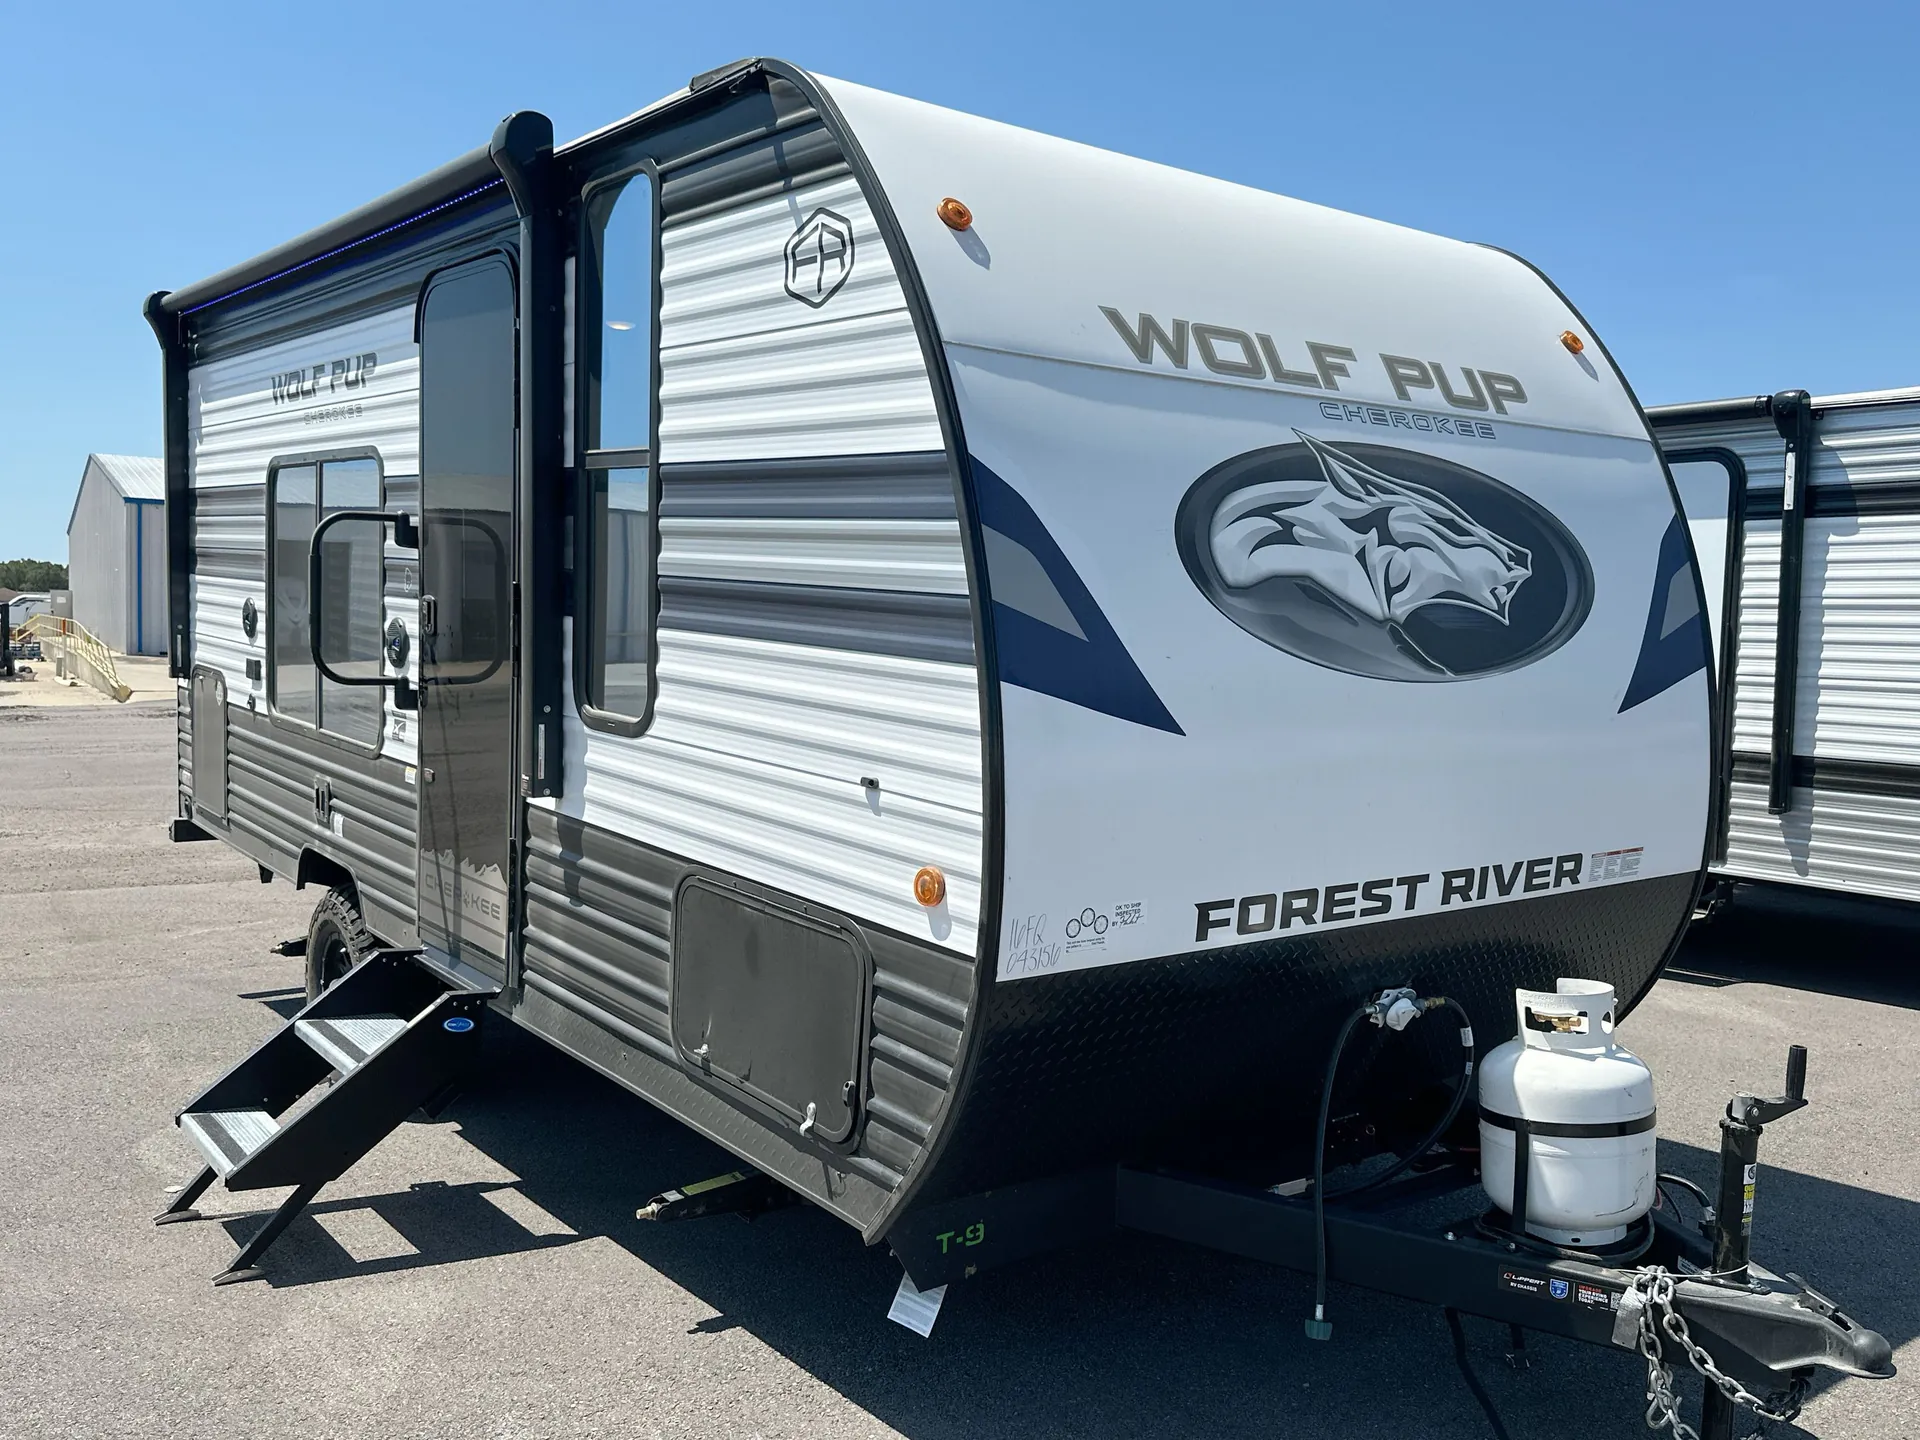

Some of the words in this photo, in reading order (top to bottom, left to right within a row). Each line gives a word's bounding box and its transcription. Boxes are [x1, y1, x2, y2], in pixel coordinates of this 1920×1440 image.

[271, 364, 326, 405] WOLF
[330, 352, 378, 394] PUP
[1097, 305, 1358, 391] WOLF
[1378, 353, 1528, 415] PUP
[303, 403, 363, 425] CHEROKEE
[1318, 402, 1497, 439] CHEROKEE
[1195, 873, 1430, 942] FOREST
[1440, 853, 1583, 905] RIVER
